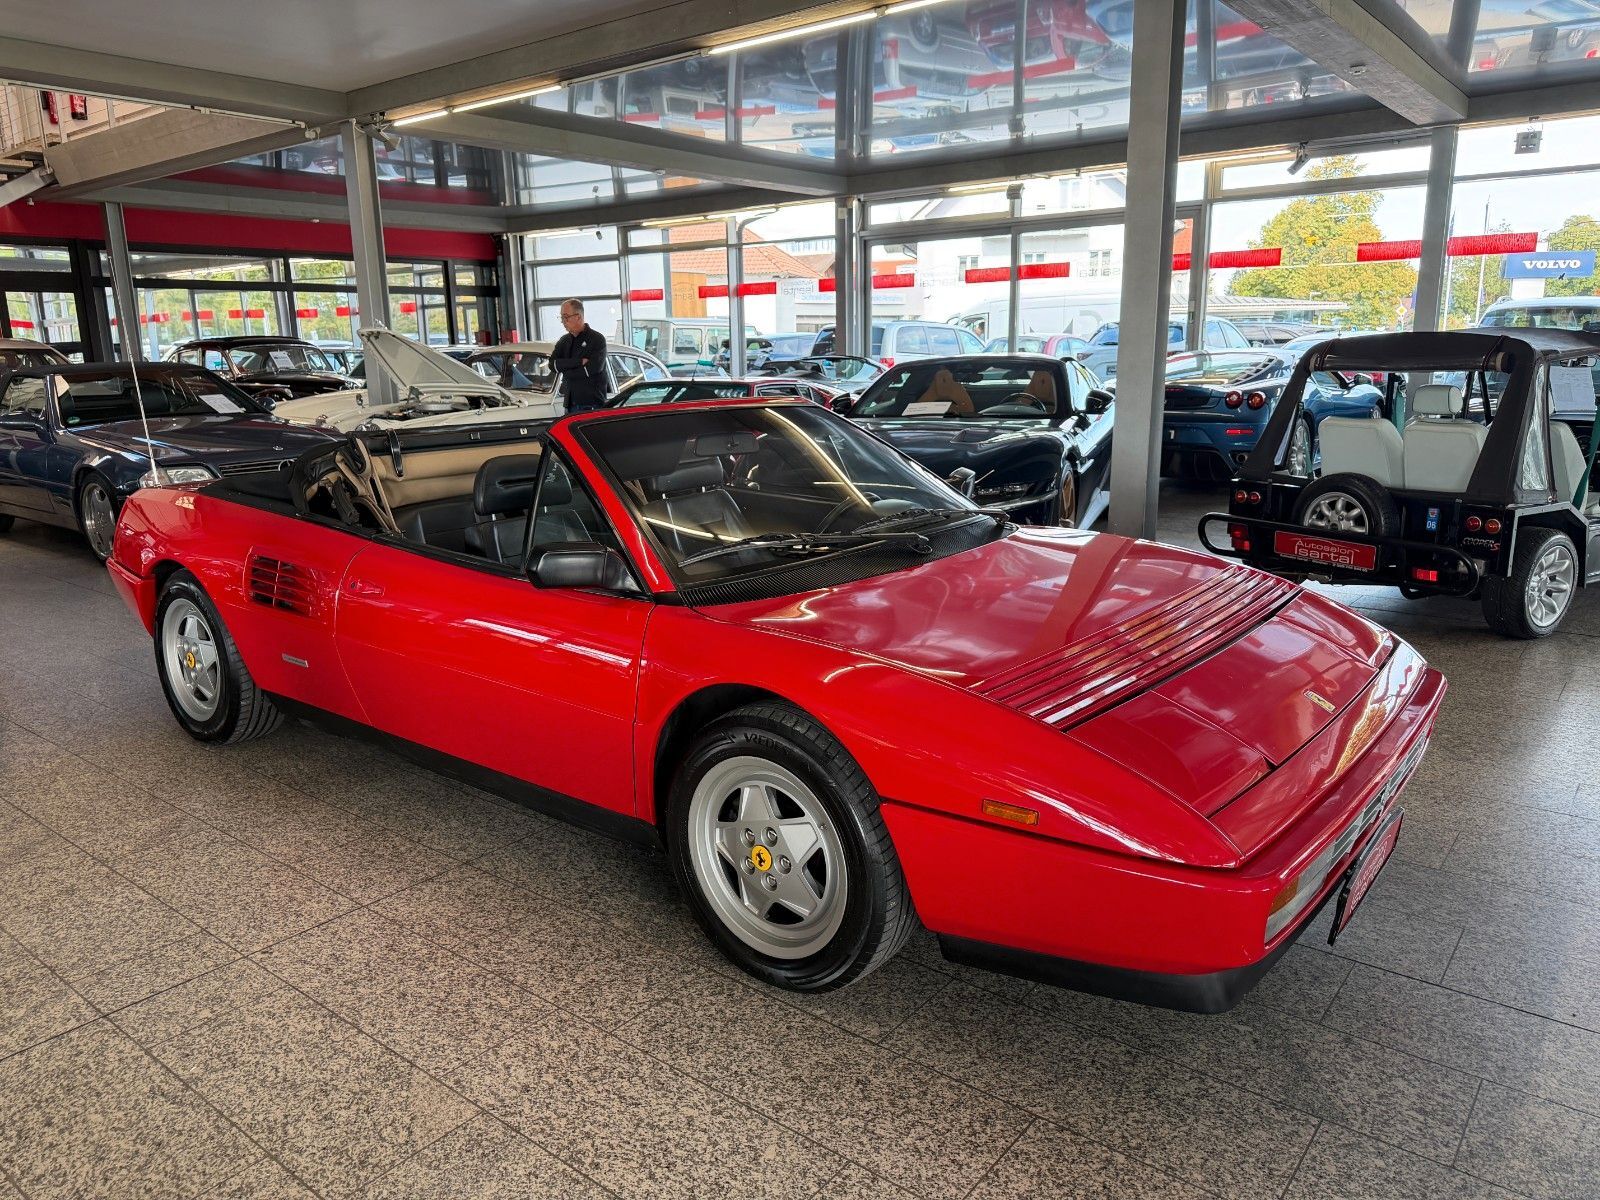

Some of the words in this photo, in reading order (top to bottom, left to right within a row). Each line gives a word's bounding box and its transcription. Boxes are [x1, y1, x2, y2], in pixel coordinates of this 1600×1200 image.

[1523, 260, 1581, 269] VOLVO
[1294, 545, 1354, 565] Isartal
[1296, 540, 1354, 555] Autosalon
